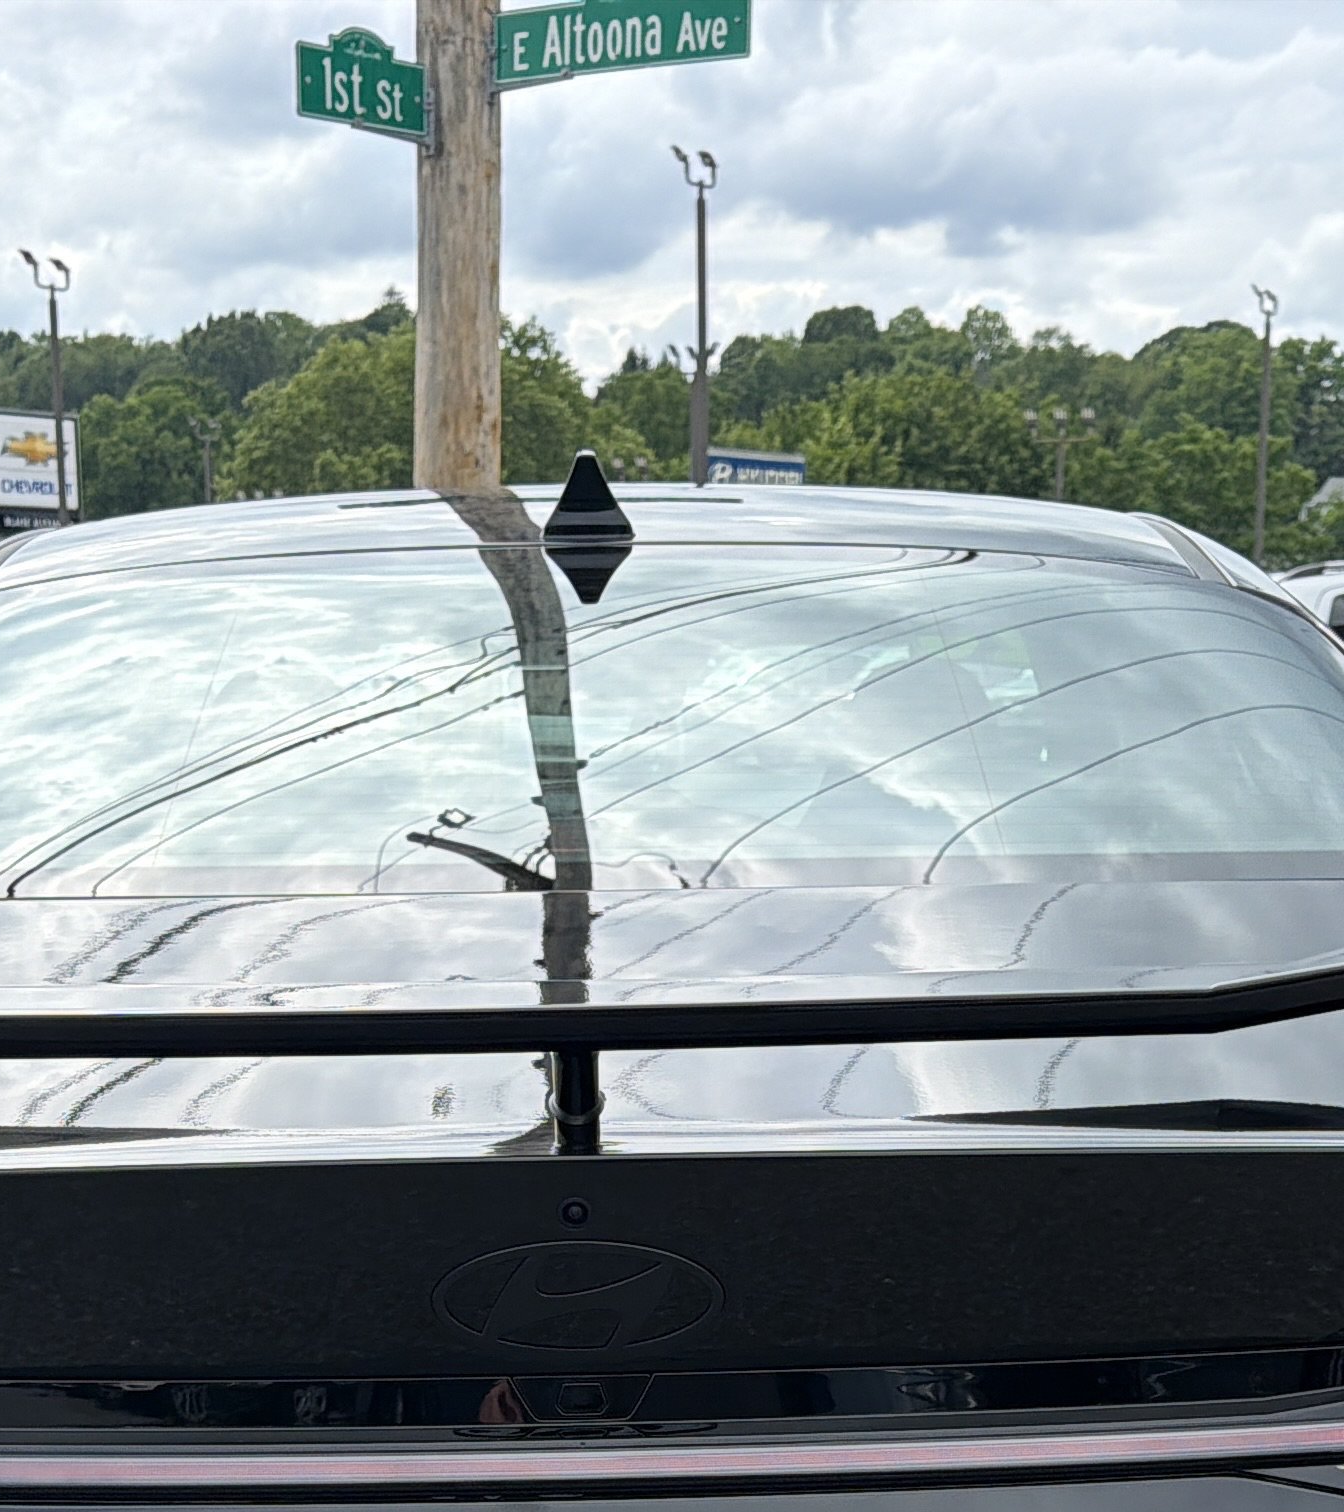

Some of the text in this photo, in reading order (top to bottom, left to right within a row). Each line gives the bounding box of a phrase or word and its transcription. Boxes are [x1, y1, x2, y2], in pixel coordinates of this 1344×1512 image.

[512, 11, 728, 72] E Altoona Ave
[322, 56, 404, 122] 1st St
[1, 479, 73, 496] CHEVROLT
